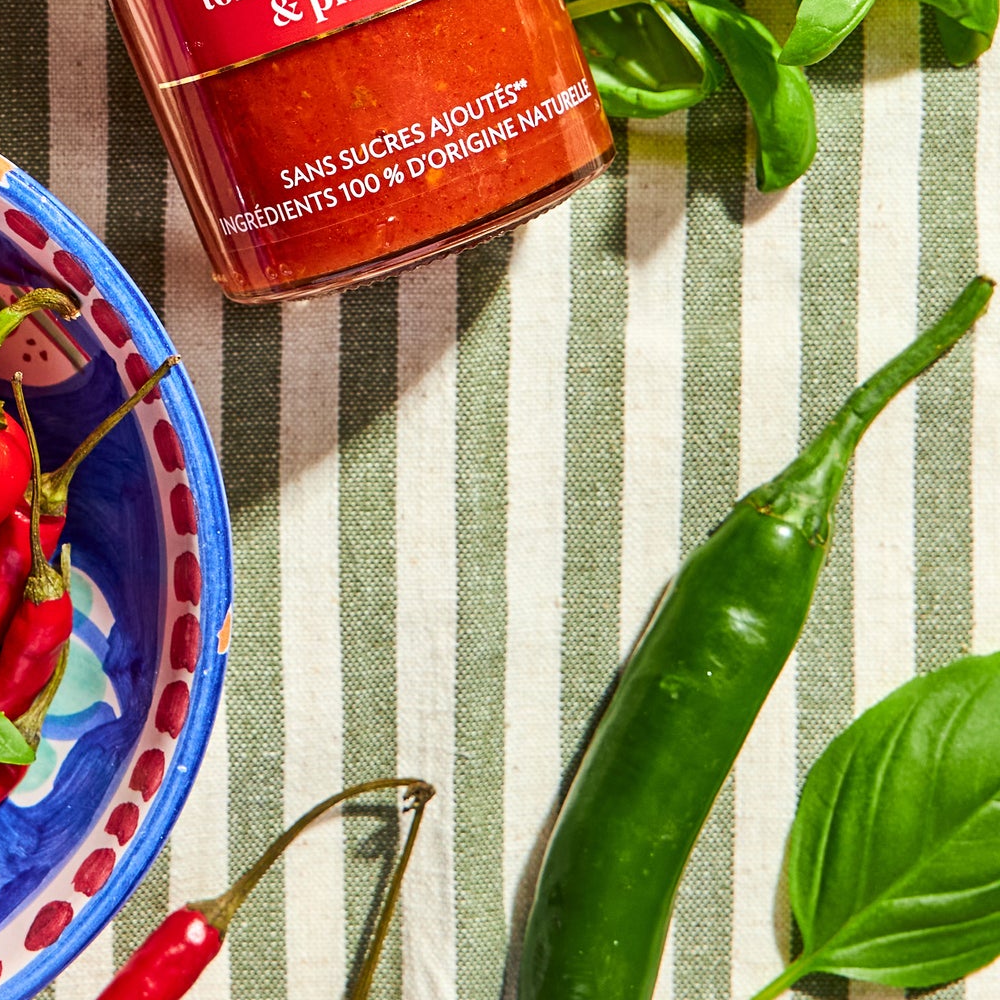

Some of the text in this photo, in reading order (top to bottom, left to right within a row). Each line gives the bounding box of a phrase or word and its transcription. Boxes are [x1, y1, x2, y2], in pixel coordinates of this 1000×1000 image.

[220, 79, 591, 236] INGRÉDIENTS 100 % D'ORIGINE NATURELLE
[280, 156, 336, 189] SANS
[339, 124, 425, 170] SUCRES
